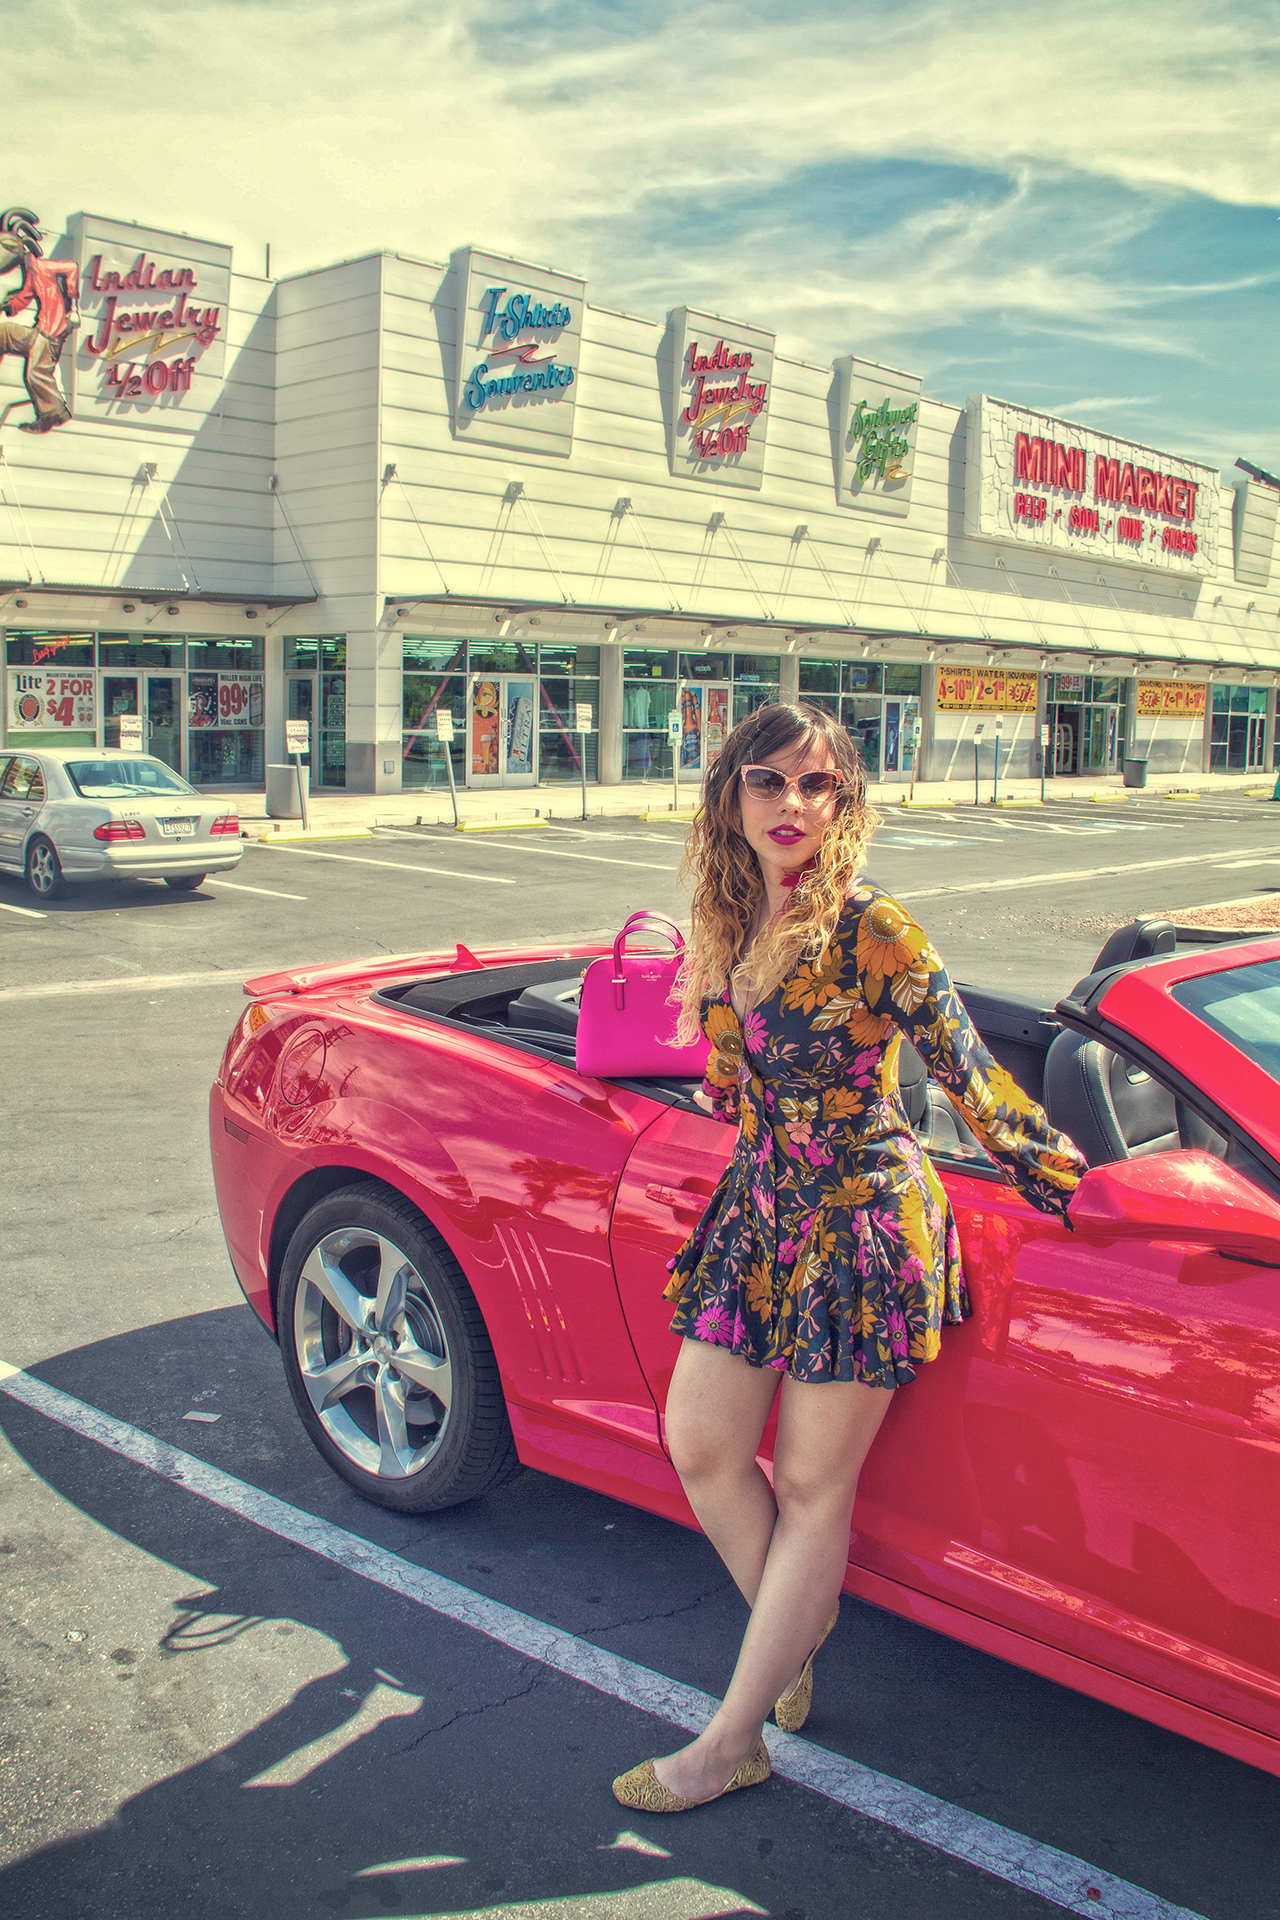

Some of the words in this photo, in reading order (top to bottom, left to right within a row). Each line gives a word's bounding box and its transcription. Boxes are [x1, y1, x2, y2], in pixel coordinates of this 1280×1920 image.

[90, 253, 197, 291] Indian
[86, 292, 221, 354] Jewelry
[484, 287, 571, 341] T-Shirts
[689, 340, 754, 373] Indian
[144, 357, 195, 395] Off
[468, 363, 575, 411] Souvenirs
[683, 372, 767, 422] Jewelry
[851, 397, 918, 442] Southwest
[718, 424, 751, 456] Off
[856, 427, 910, 482] Gifts
[1014, 431, 1087, 493] MINI
[1094, 454, 1199, 521] MARKET
[1014, 492, 1047, 521] BEER
[1069, 505, 1100, 533] SODA
[1118, 516, 1145, 542] WINE
[1162, 526, 1198, 554] SNACKS
[15, 674, 43, 693] Lite
[46, 679, 56, 696] 2
[61, 679, 94, 696] FOR
[220, 674, 238, 682] MILLER
[939, 667, 972, 677] T-SHIRTS
[977, 669, 1005, 679] WATER
[1007, 671, 1038, 681] SOUVENIRS
[939, 678, 947, 700] 4
[976, 679, 985, 701] 2
[1139, 680, 1162, 688] SOUVENIRS
[46, 697, 74, 726] $4
[220, 683, 248, 718] 99¢
[233, 718, 247, 726] CANS
